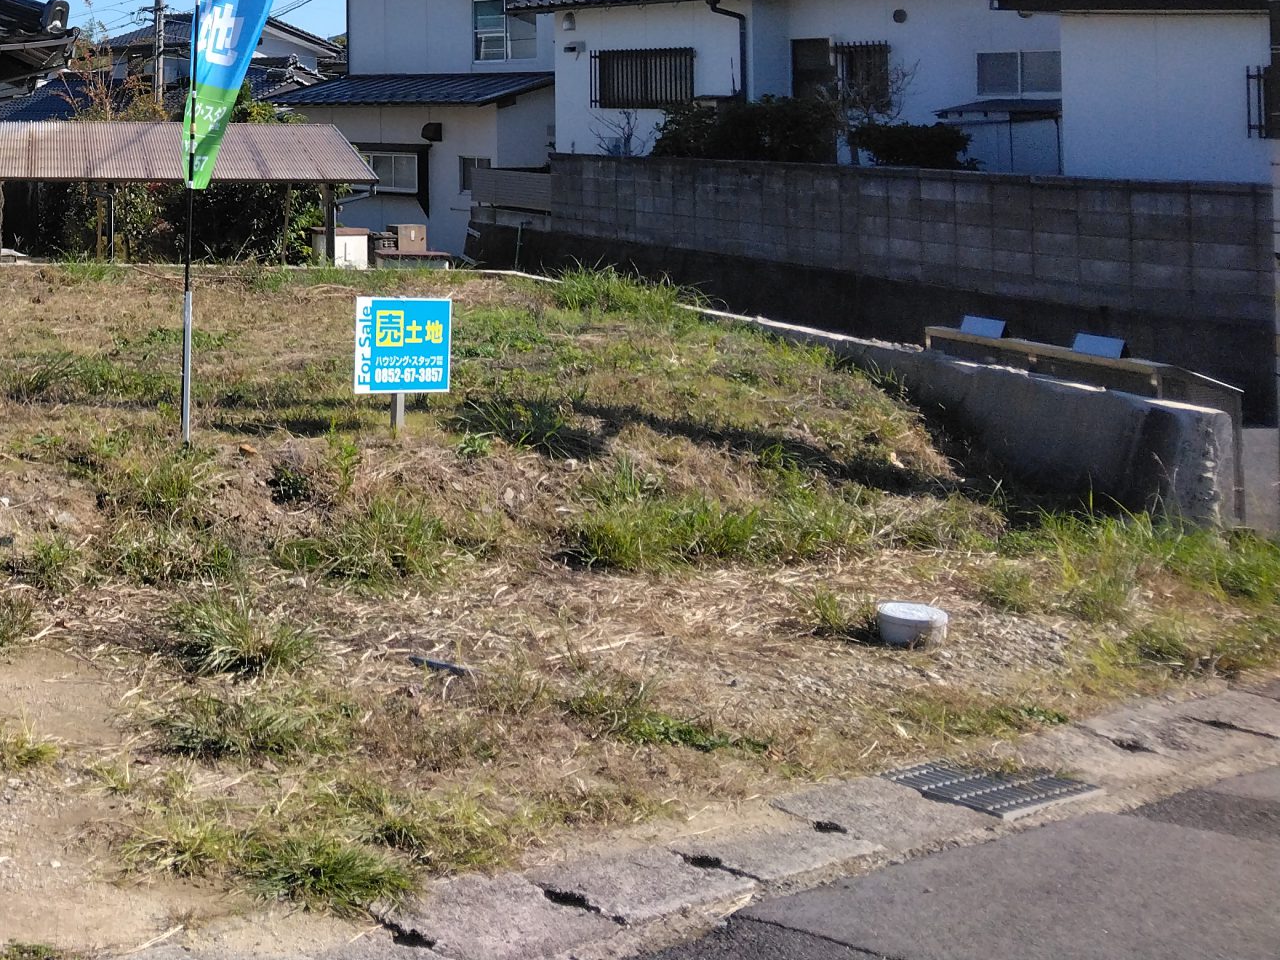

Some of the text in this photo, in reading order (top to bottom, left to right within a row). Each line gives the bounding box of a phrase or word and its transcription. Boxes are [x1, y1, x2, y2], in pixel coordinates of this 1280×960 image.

[357, 305, 372, 386] For Sale
[377, 311, 443, 345] 売土地
